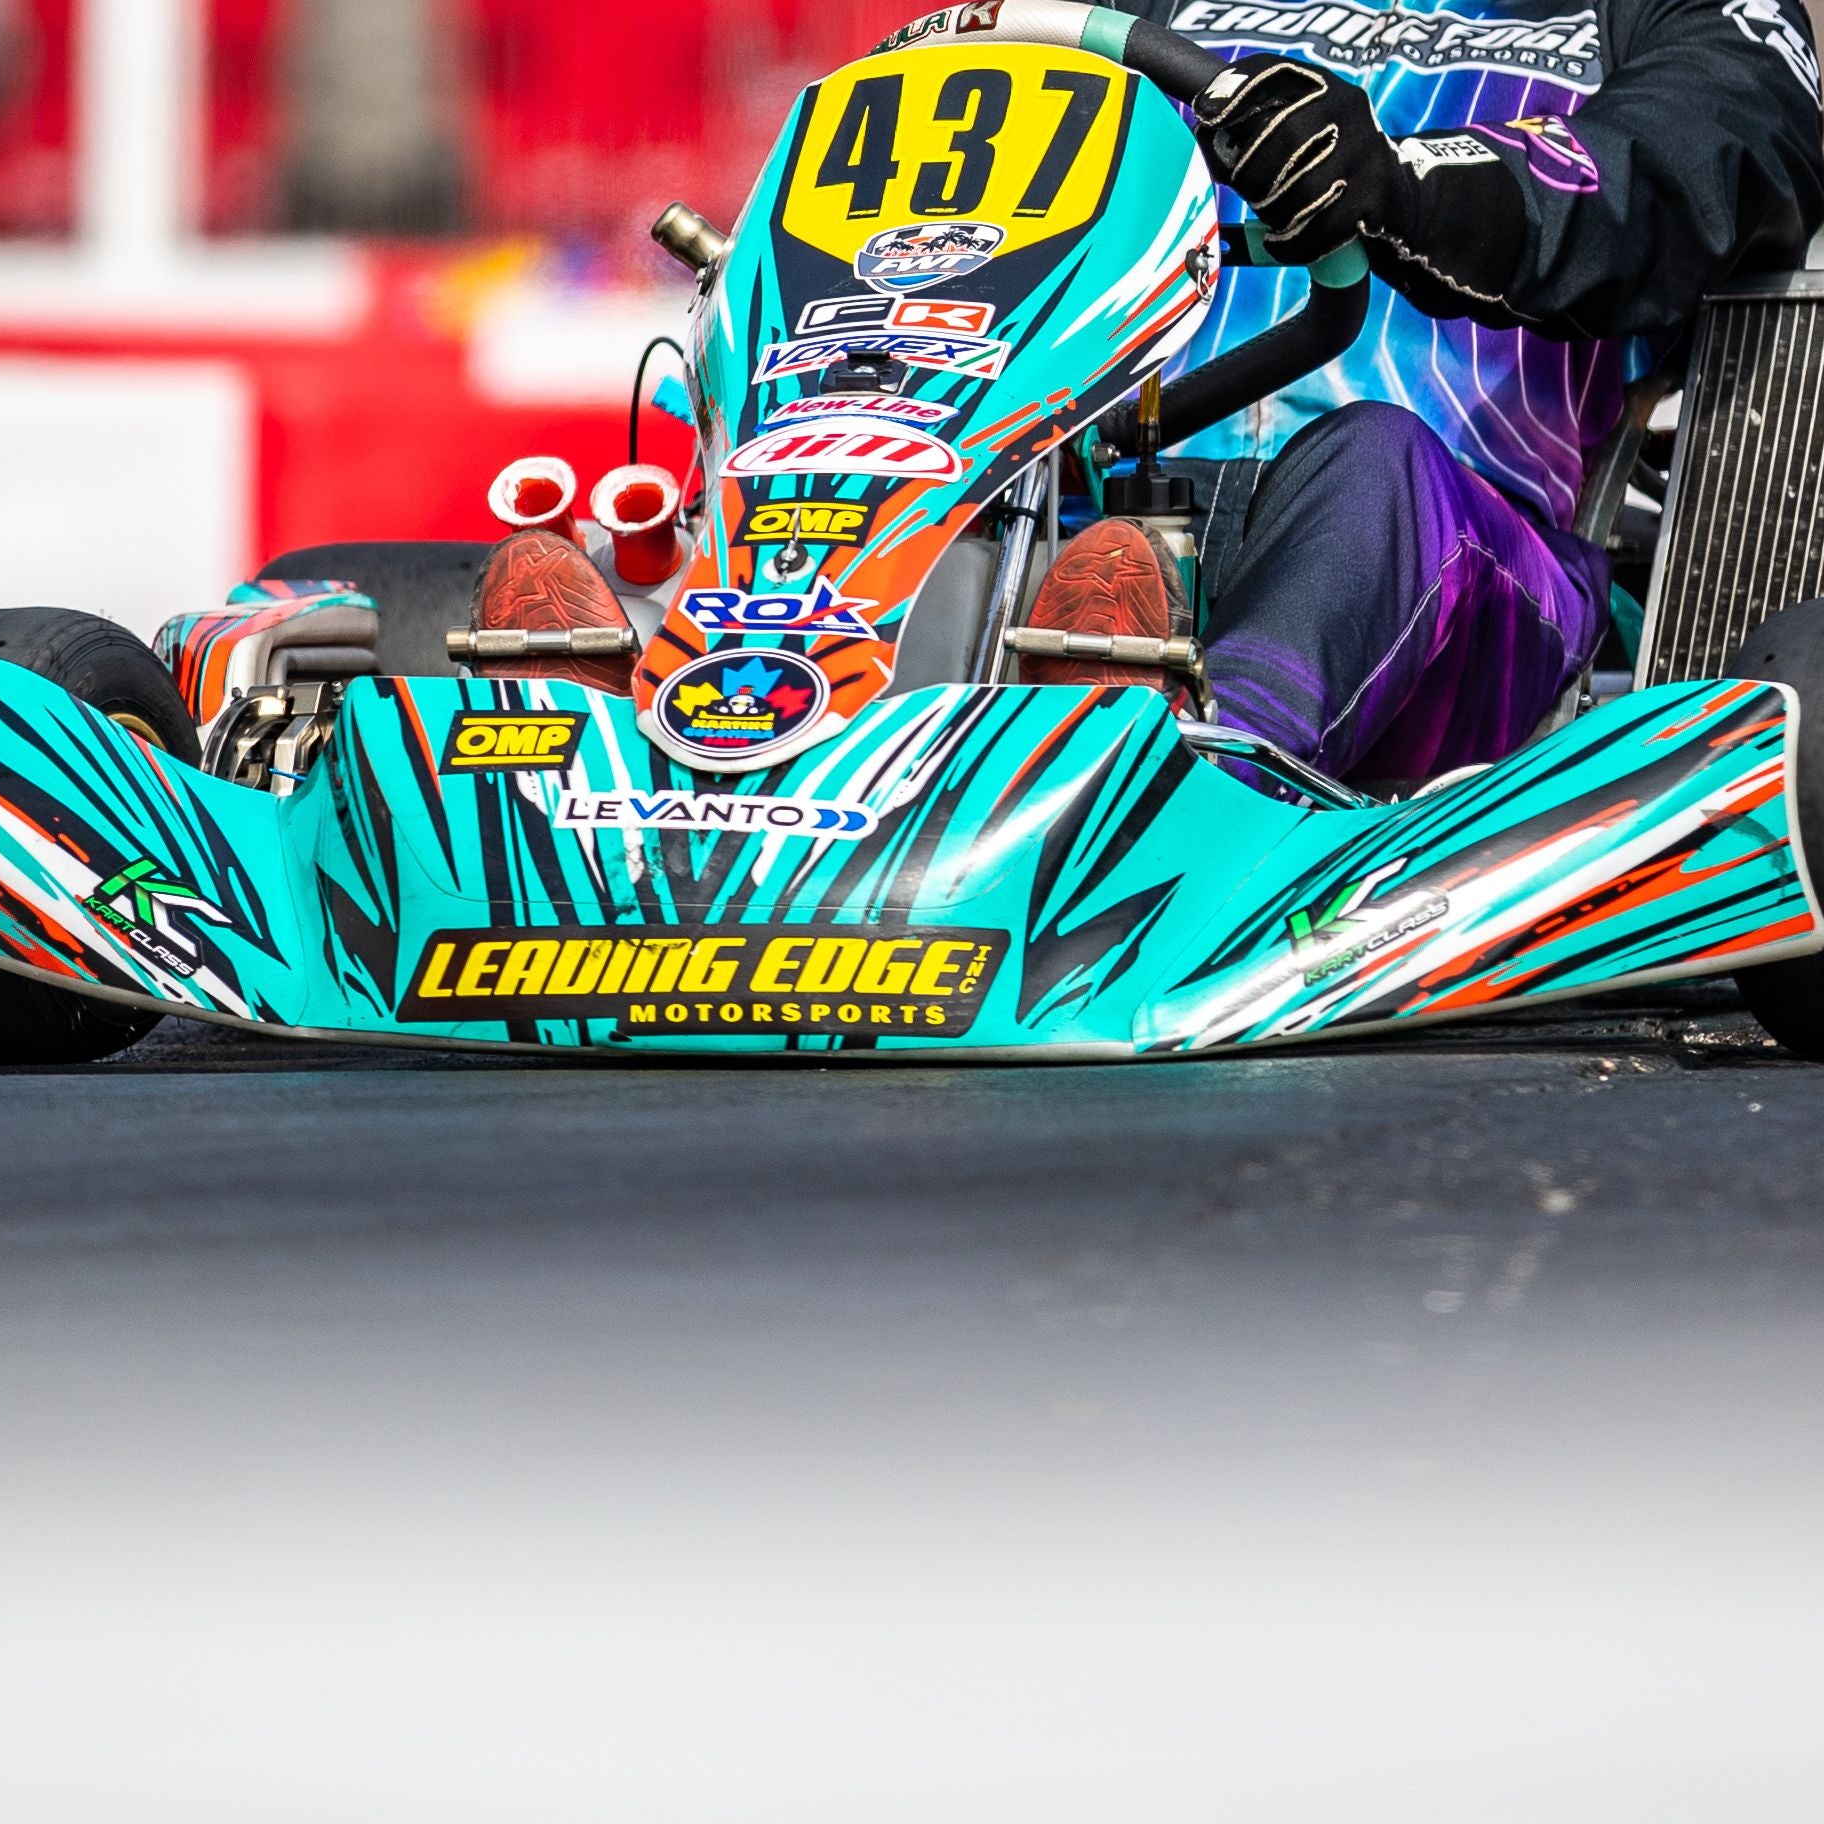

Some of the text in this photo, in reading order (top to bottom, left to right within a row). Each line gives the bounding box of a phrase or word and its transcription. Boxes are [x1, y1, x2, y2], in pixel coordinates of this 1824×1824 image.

[1330, 42, 1584, 76] MOORSPORTS
[814, 69, 1110, 221] 437
[871, 254, 975, 273] FWT
[776, 397, 943, 418] New-Line
[749, 508, 865, 533] OMP
[456, 724, 572, 756] OMP
[565, 797, 804, 827] LEVANTO
[84, 896, 195, 976] KARTCLASS
[418, 937, 976, 998] LEADING EDGE
[629, 1002, 946, 1025] MOTORSPORTS
